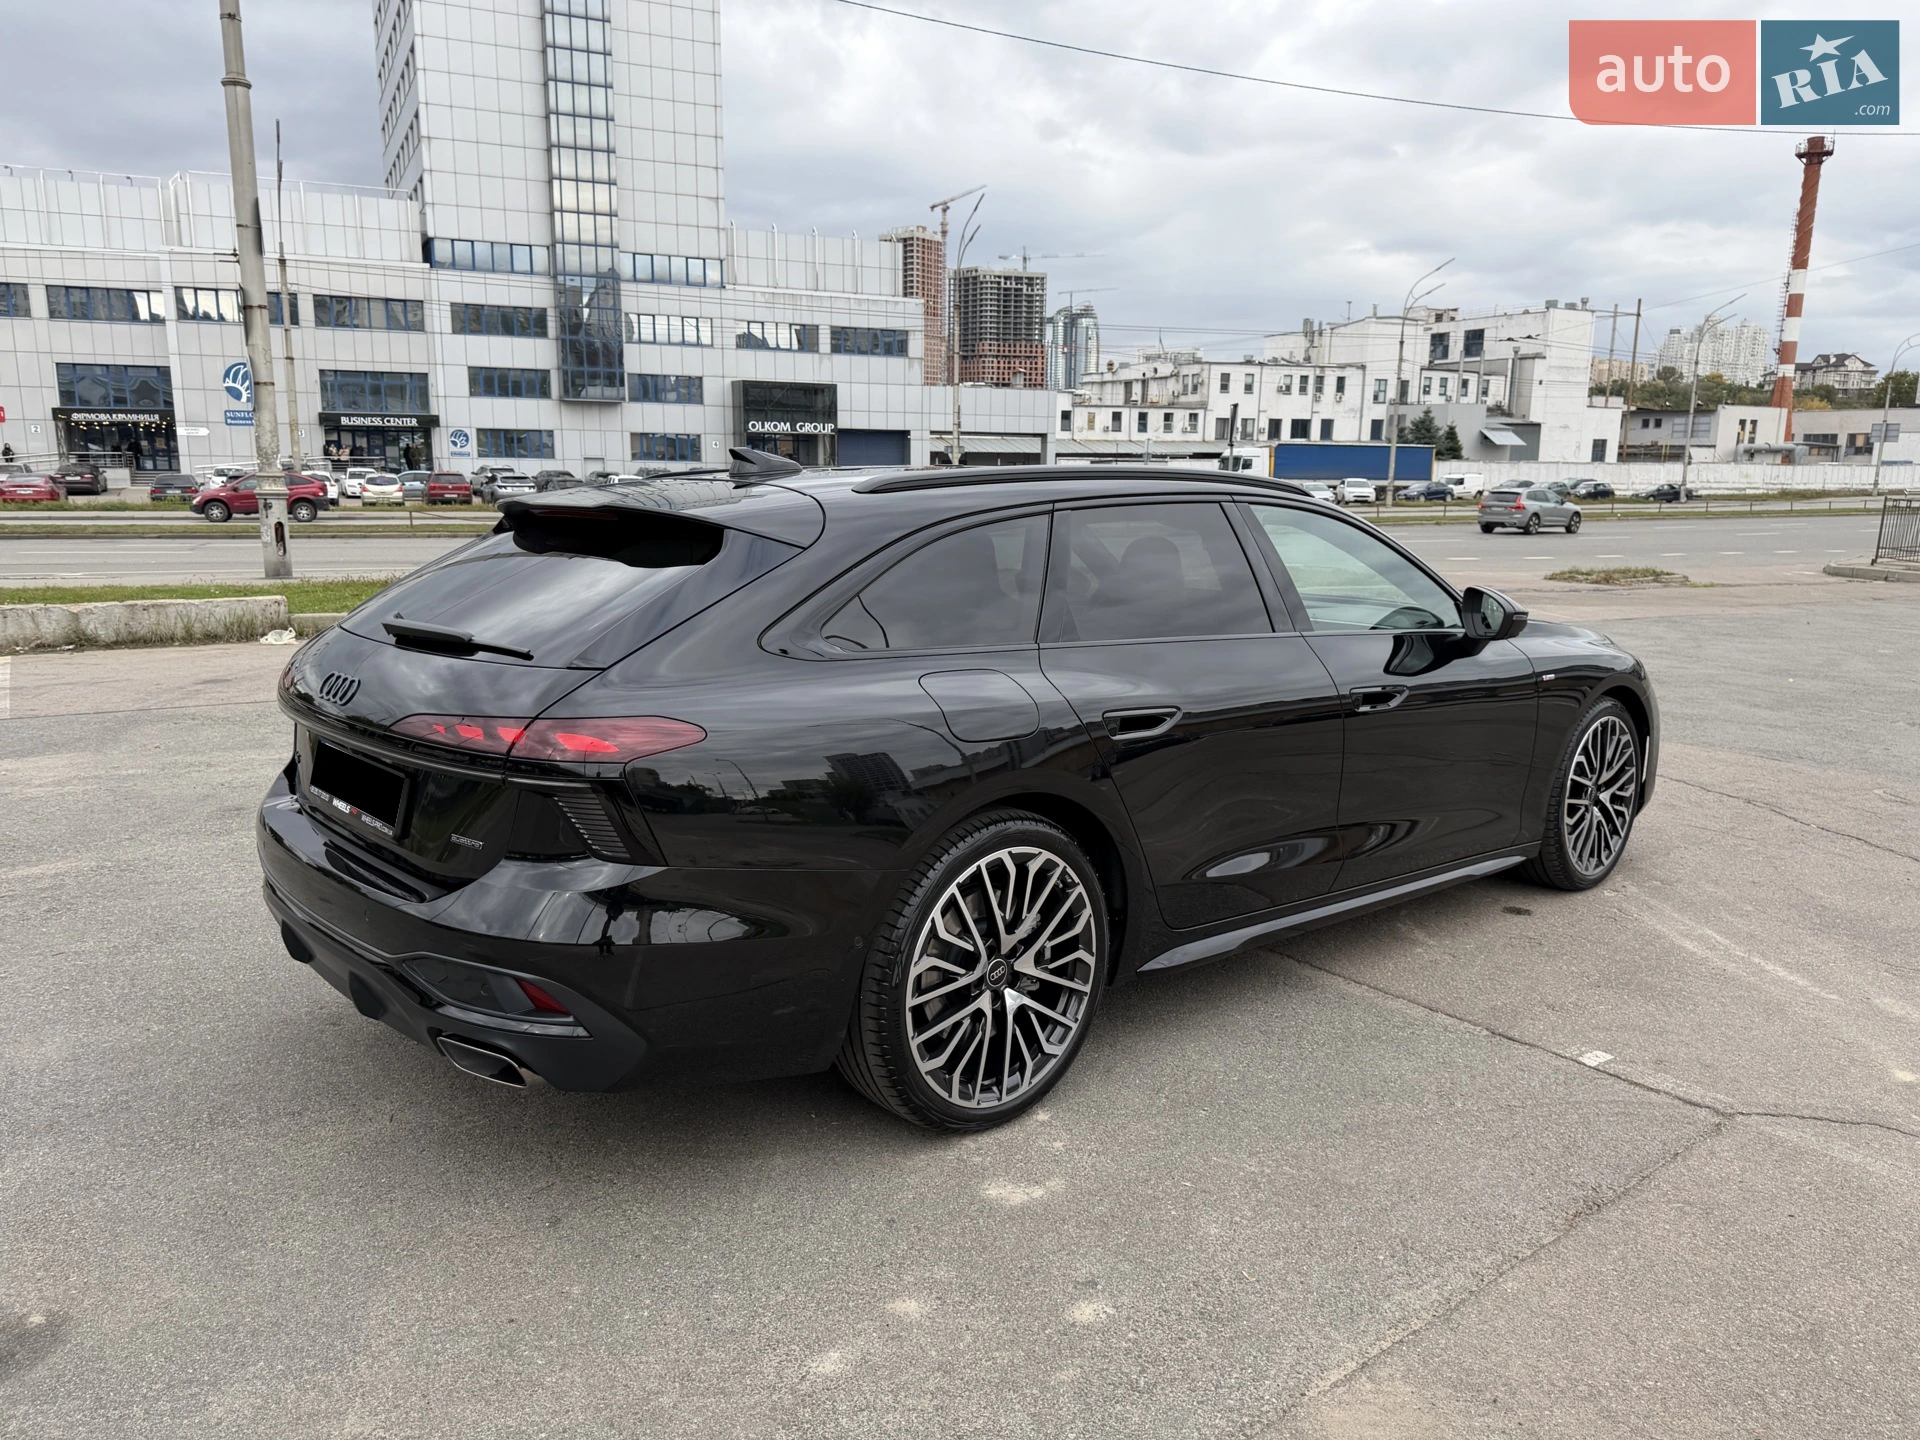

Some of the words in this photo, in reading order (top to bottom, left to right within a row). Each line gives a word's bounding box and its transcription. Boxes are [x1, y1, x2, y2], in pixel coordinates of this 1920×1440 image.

[71, 412, 111, 420] ФІРМОВА
[112, 413, 159, 421] КРАМНИЦЯ
[341, 416, 383, 425] BUSINESS
[384, 417, 418, 426] CENTER
[748, 421, 791, 432] OLKOM
[796, 422, 835, 433] GROUP
[332, 797, 351, 814] WHEELS
[450, 835, 481, 849] quattro
